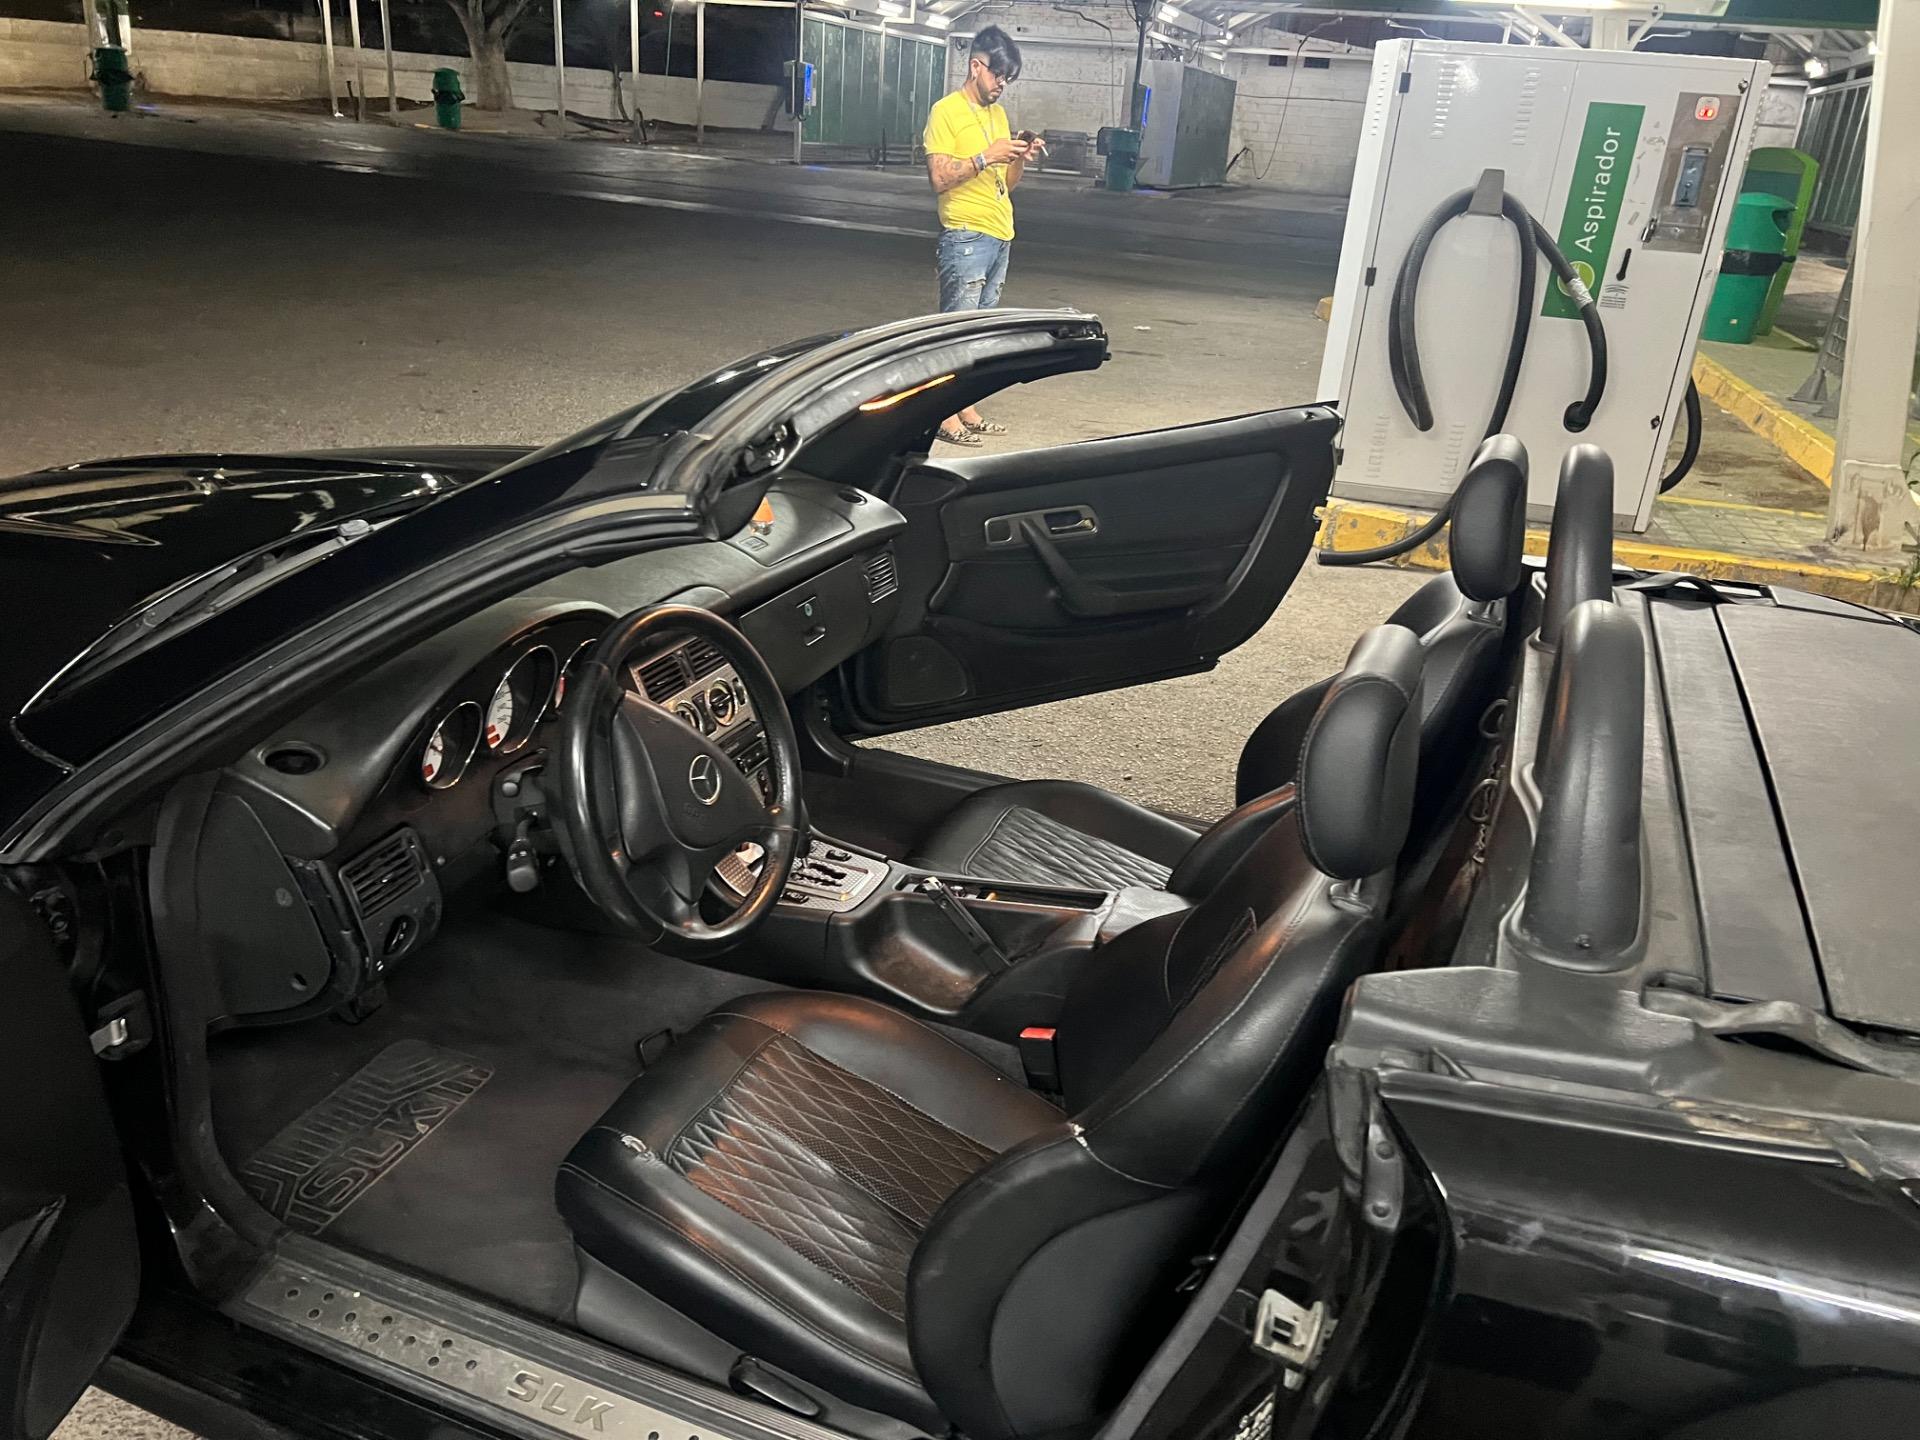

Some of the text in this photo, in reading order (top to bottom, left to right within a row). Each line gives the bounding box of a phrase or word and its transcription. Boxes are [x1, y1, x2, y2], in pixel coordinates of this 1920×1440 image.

[1575, 126, 1621, 253] Aspirador
[299, 1100, 448, 1206] SLK
[506, 1370, 615, 1432] SLK
